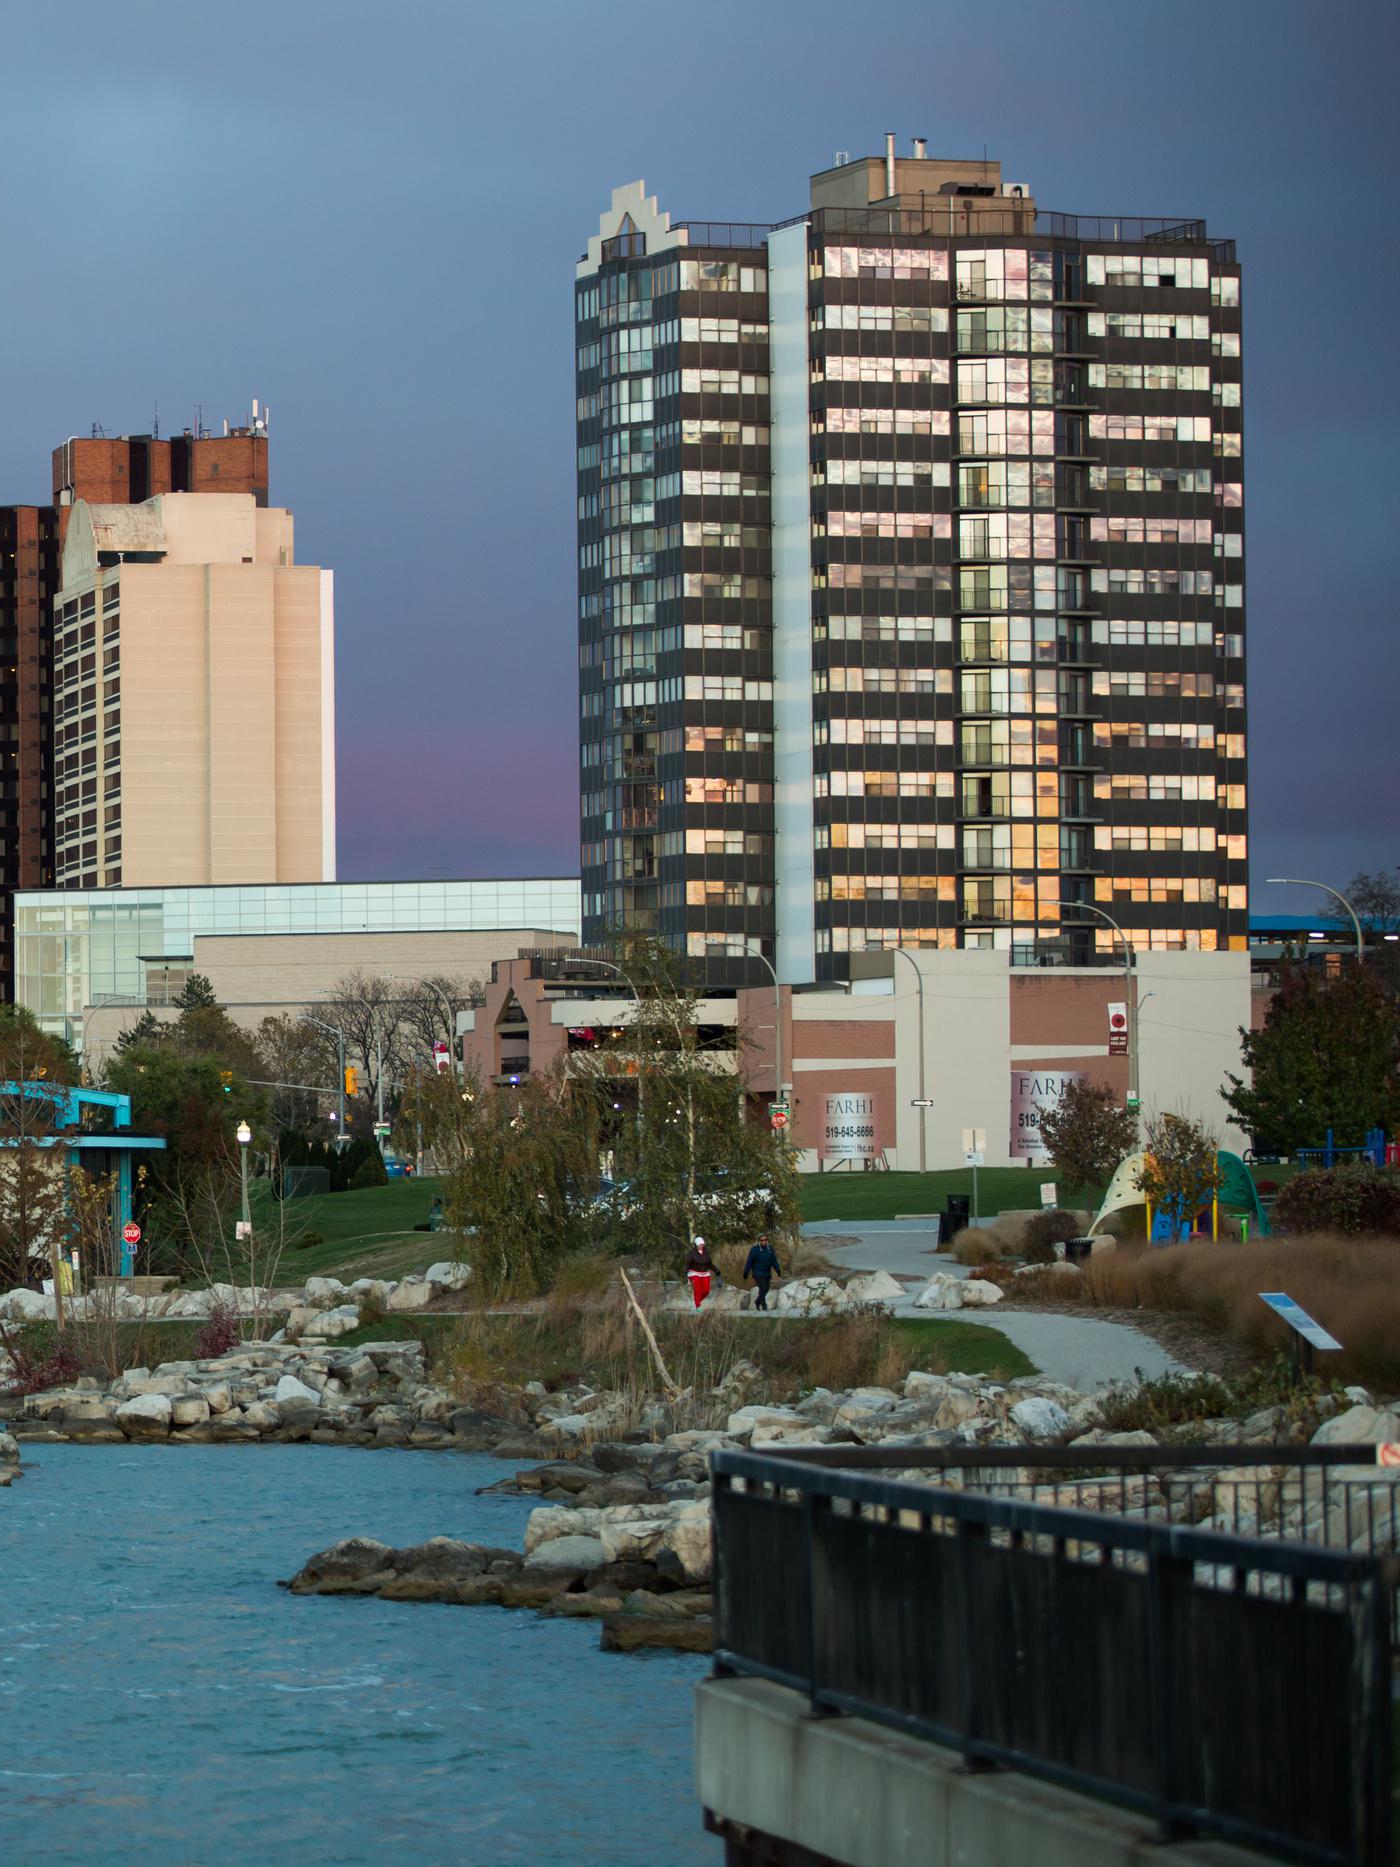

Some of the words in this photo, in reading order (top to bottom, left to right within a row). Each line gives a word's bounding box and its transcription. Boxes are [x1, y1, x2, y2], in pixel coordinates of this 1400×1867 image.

[1019, 1078, 1073, 1095] FARH
[826, 1099, 873, 1114] FARHI
[825, 1126, 874, 1138] 519-645-6666
[124, 1229, 139, 1238] STOP
